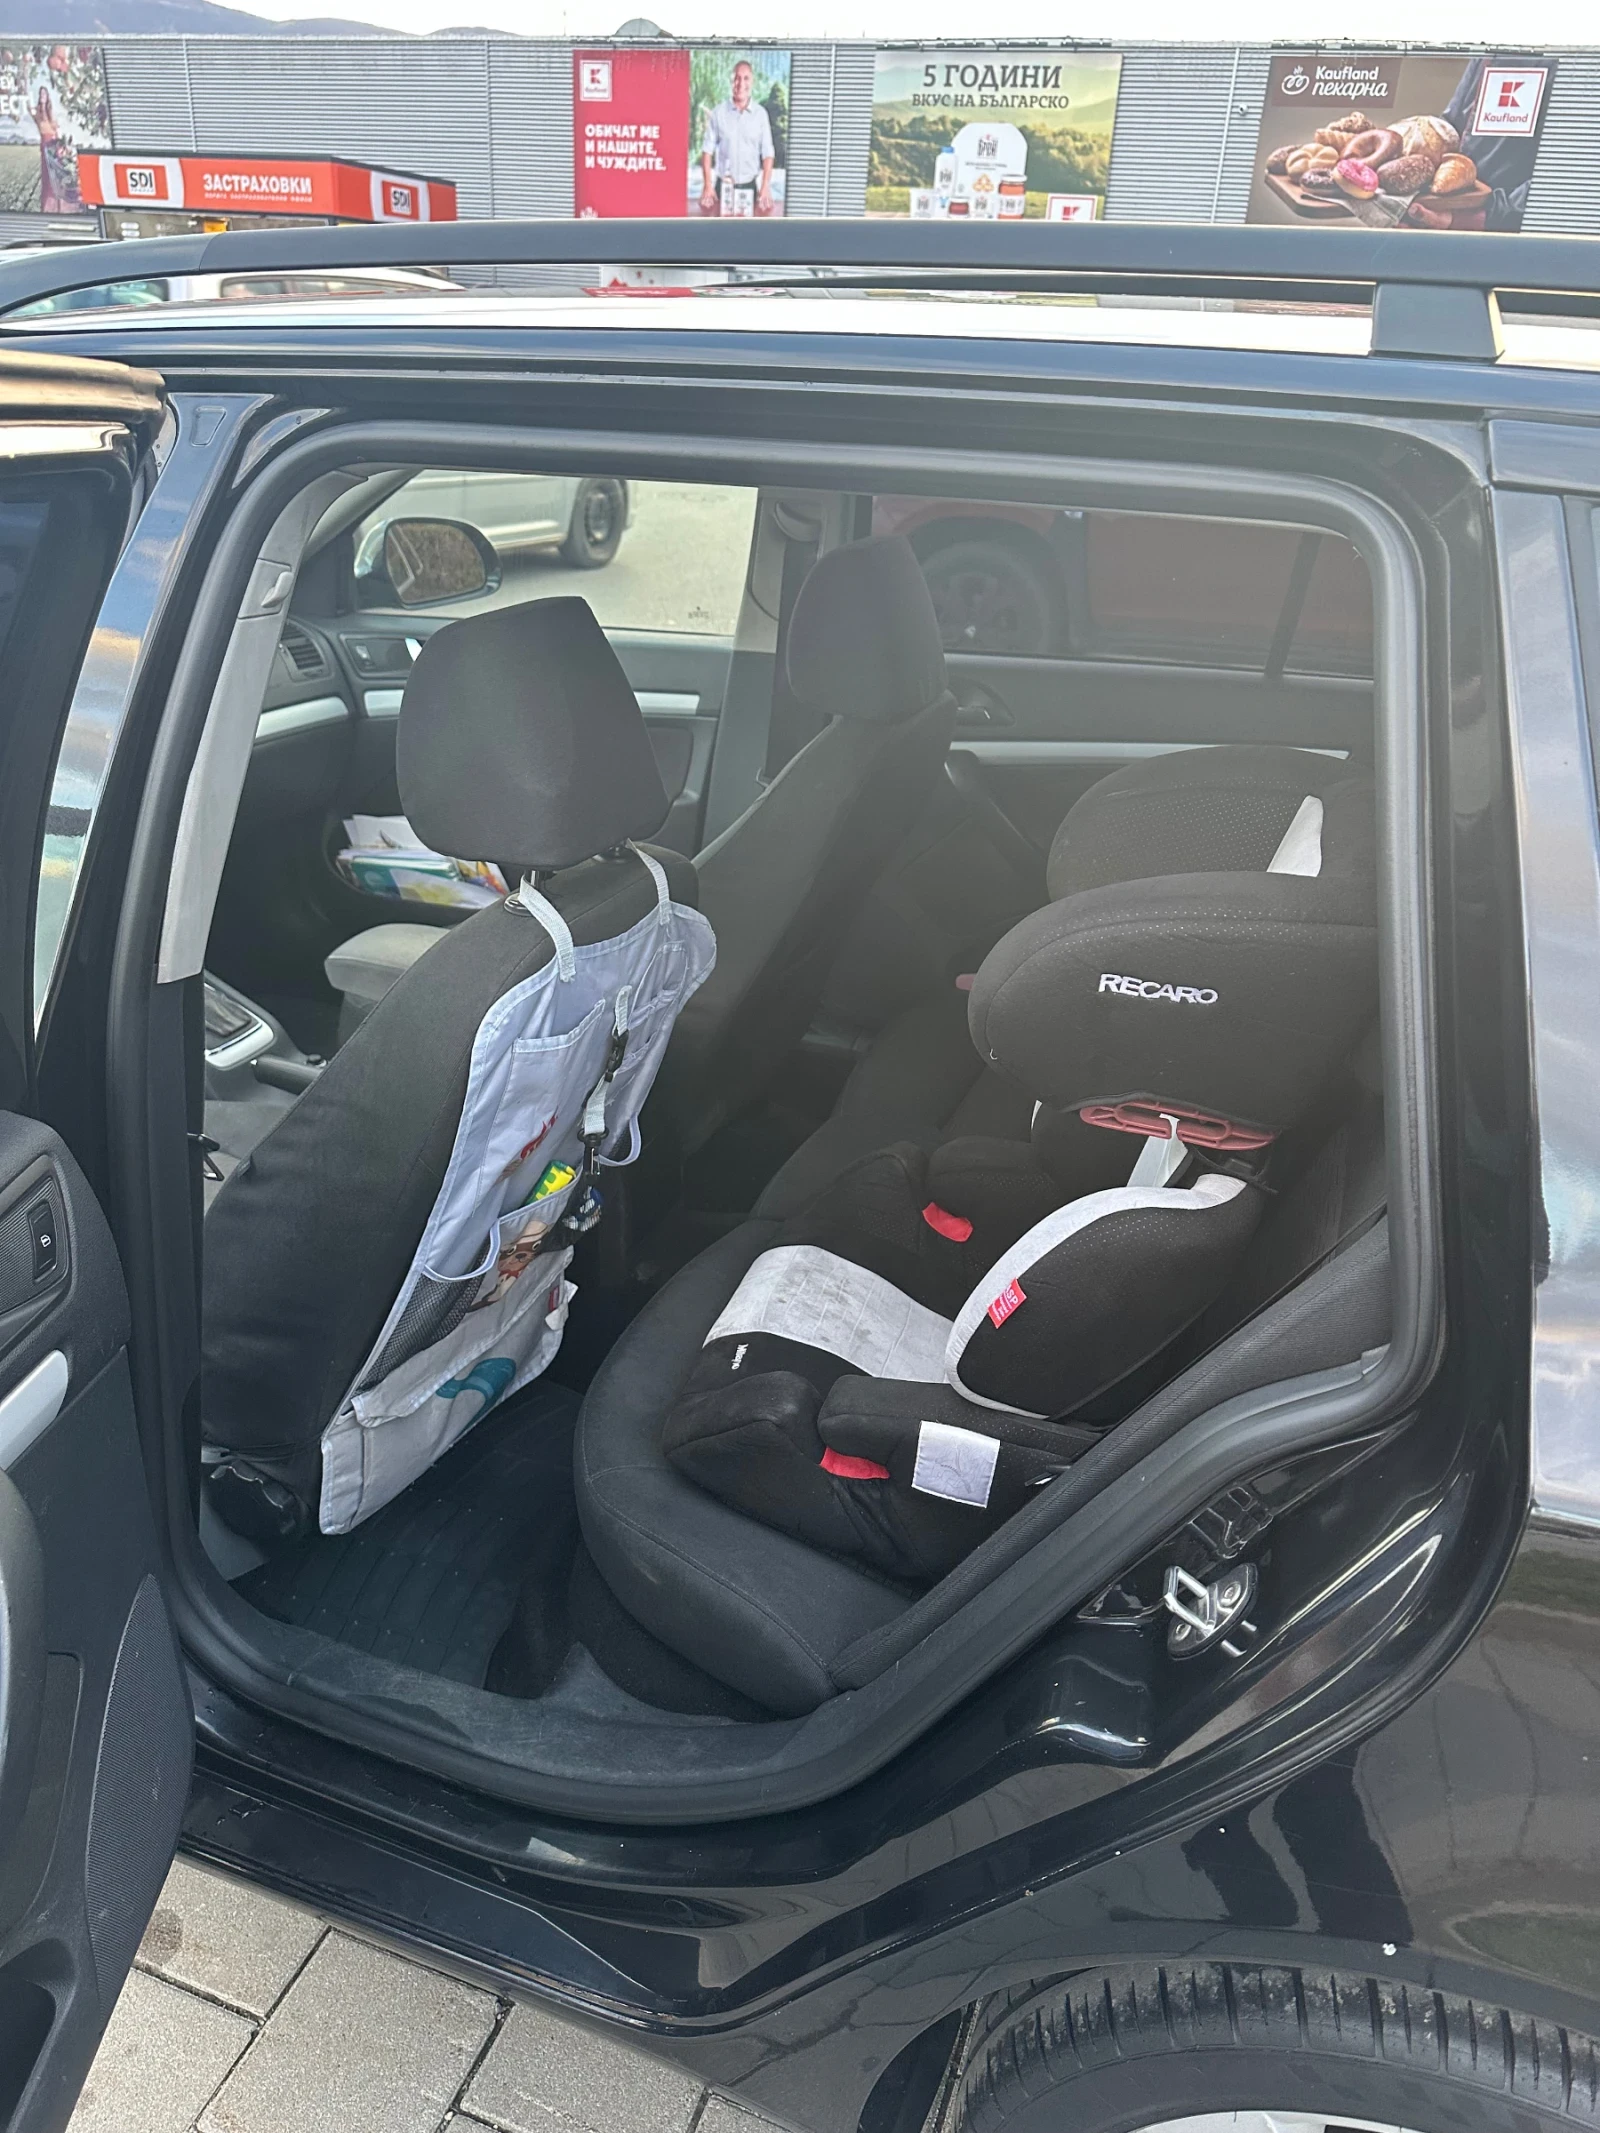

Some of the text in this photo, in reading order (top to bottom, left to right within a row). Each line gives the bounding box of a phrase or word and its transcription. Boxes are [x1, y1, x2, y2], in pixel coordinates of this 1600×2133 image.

[923, 64, 1062, 92] 5 ГОДИНИ
[1315, 65, 1379, 80] Kaufland
[1312, 81, 1388, 100] пекарна
[912, 93, 1069, 109] ВКУС НА БЪЛГАРСКО
[1483, 113, 1529, 123] Kaufland
[584, 124, 660, 139] ОБИЧАТ МЕ
[585, 139, 657, 156] И НАШИТЕ,
[585, 155, 667, 172] И ЧУЖДИТЕ.
[129, 171, 153, 188] SDI
[203, 173, 312, 194] ЗАСТРАХОВКИ
[393, 190, 410, 207] SDI
[1098, 973, 1219, 1004] RECARO
